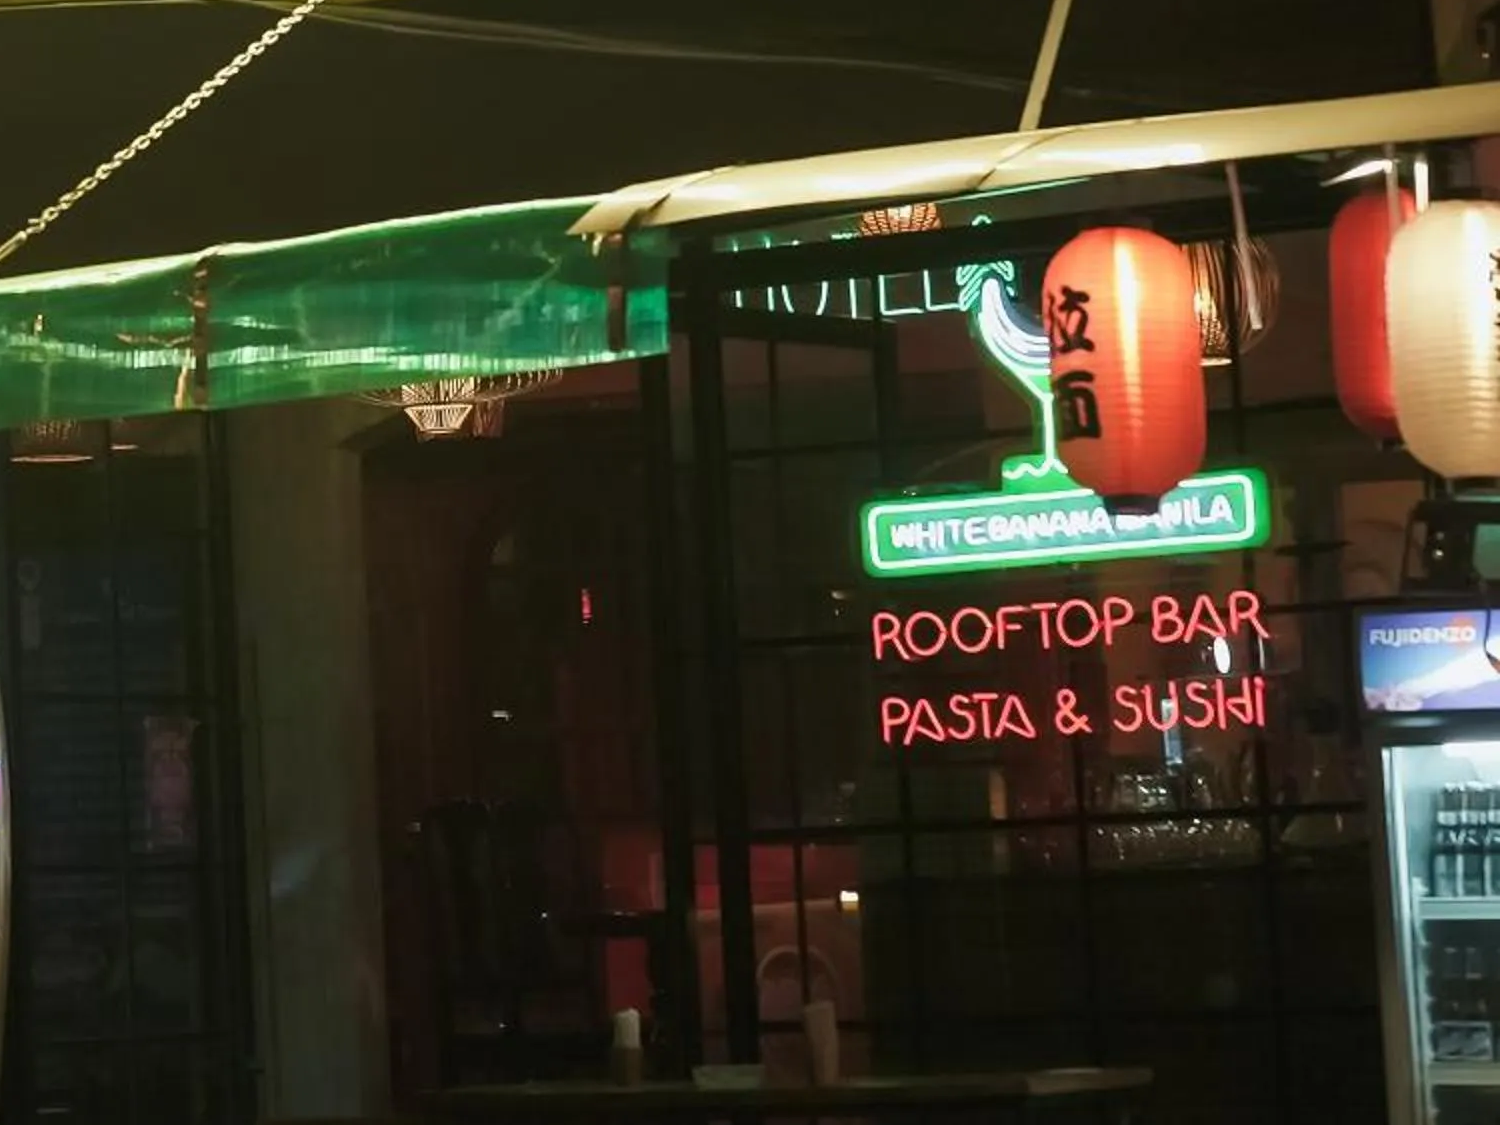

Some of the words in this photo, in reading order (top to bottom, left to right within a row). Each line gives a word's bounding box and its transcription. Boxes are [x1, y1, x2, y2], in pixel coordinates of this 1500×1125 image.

[871, 596, 1135, 661] ROOFTOP
[1151, 591, 1271, 644] BAR
[880, 692, 1037, 746] PASTA
[1054, 687, 1093, 735] &
